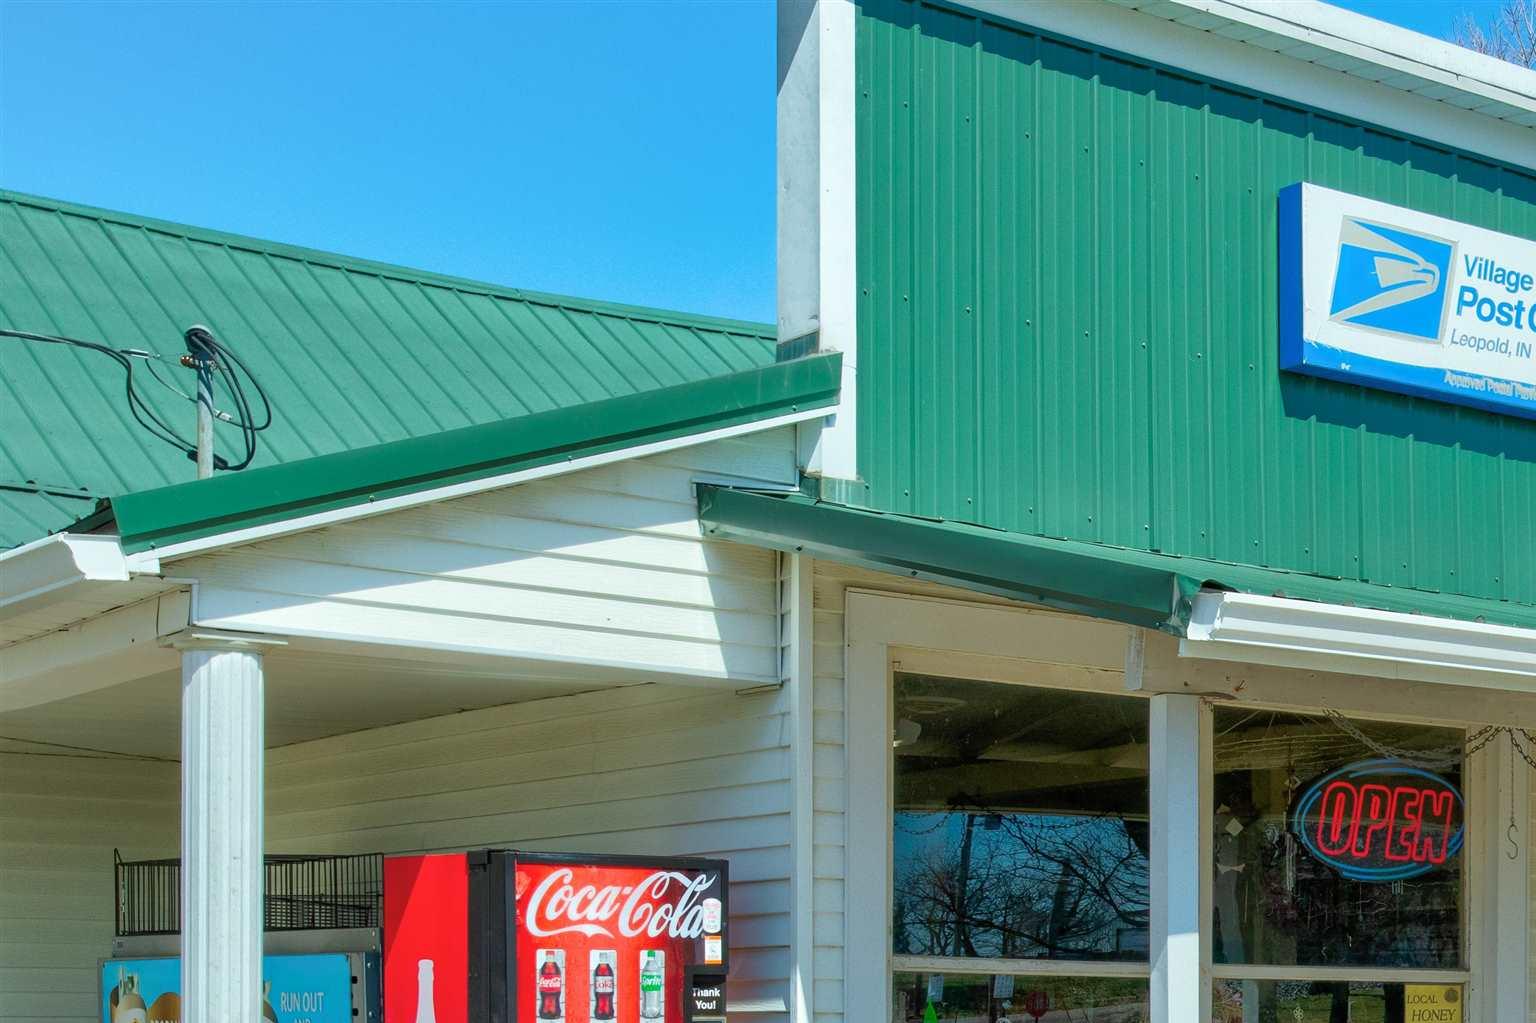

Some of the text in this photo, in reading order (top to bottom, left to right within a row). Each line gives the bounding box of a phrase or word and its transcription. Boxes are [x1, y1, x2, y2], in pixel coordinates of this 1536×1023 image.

[1464, 254, 1534, 294] Village
[1456, 285, 1525, 328] Post
[1450, 328, 1512, 359] Leopold,
[1516, 340, 1532, 360] IN
[1316, 780, 1454, 864] OPEN
[526, 867, 717, 939] Coca-Cola
[281, 992, 324, 1012] RUN OUT
[692, 987, 721, 997] Thank
[696, 1000, 716, 1010] You!
[1407, 994, 1439, 1004] LOCAL
[1412, 1009, 1456, 1022] HONEY
